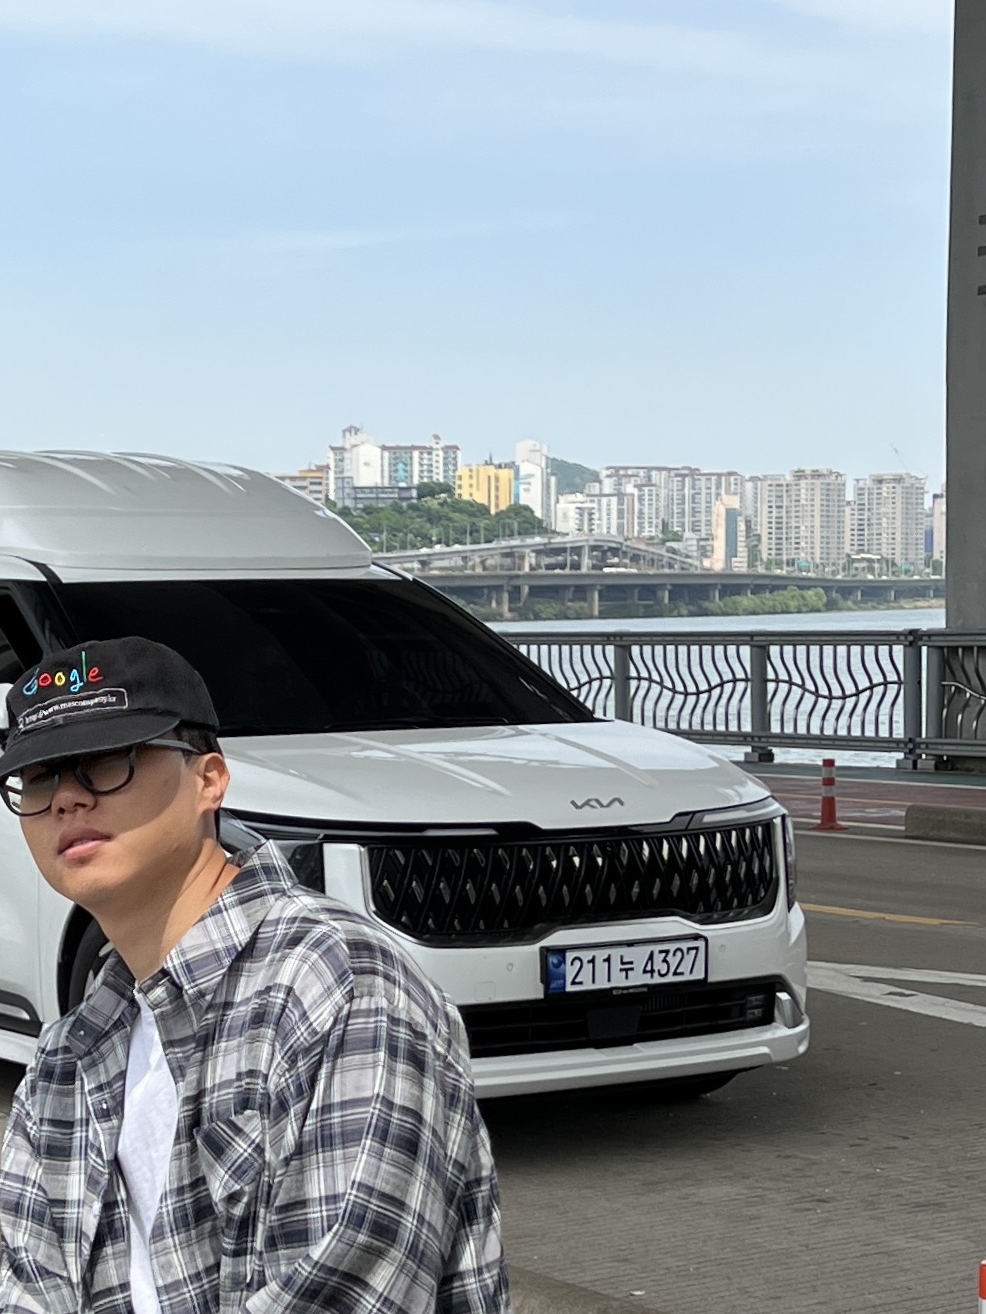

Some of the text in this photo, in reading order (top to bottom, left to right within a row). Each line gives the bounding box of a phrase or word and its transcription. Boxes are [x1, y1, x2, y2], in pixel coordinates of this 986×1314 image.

[23, 651, 103, 695] Google
[570, 946, 700, 985] 211누 4327
